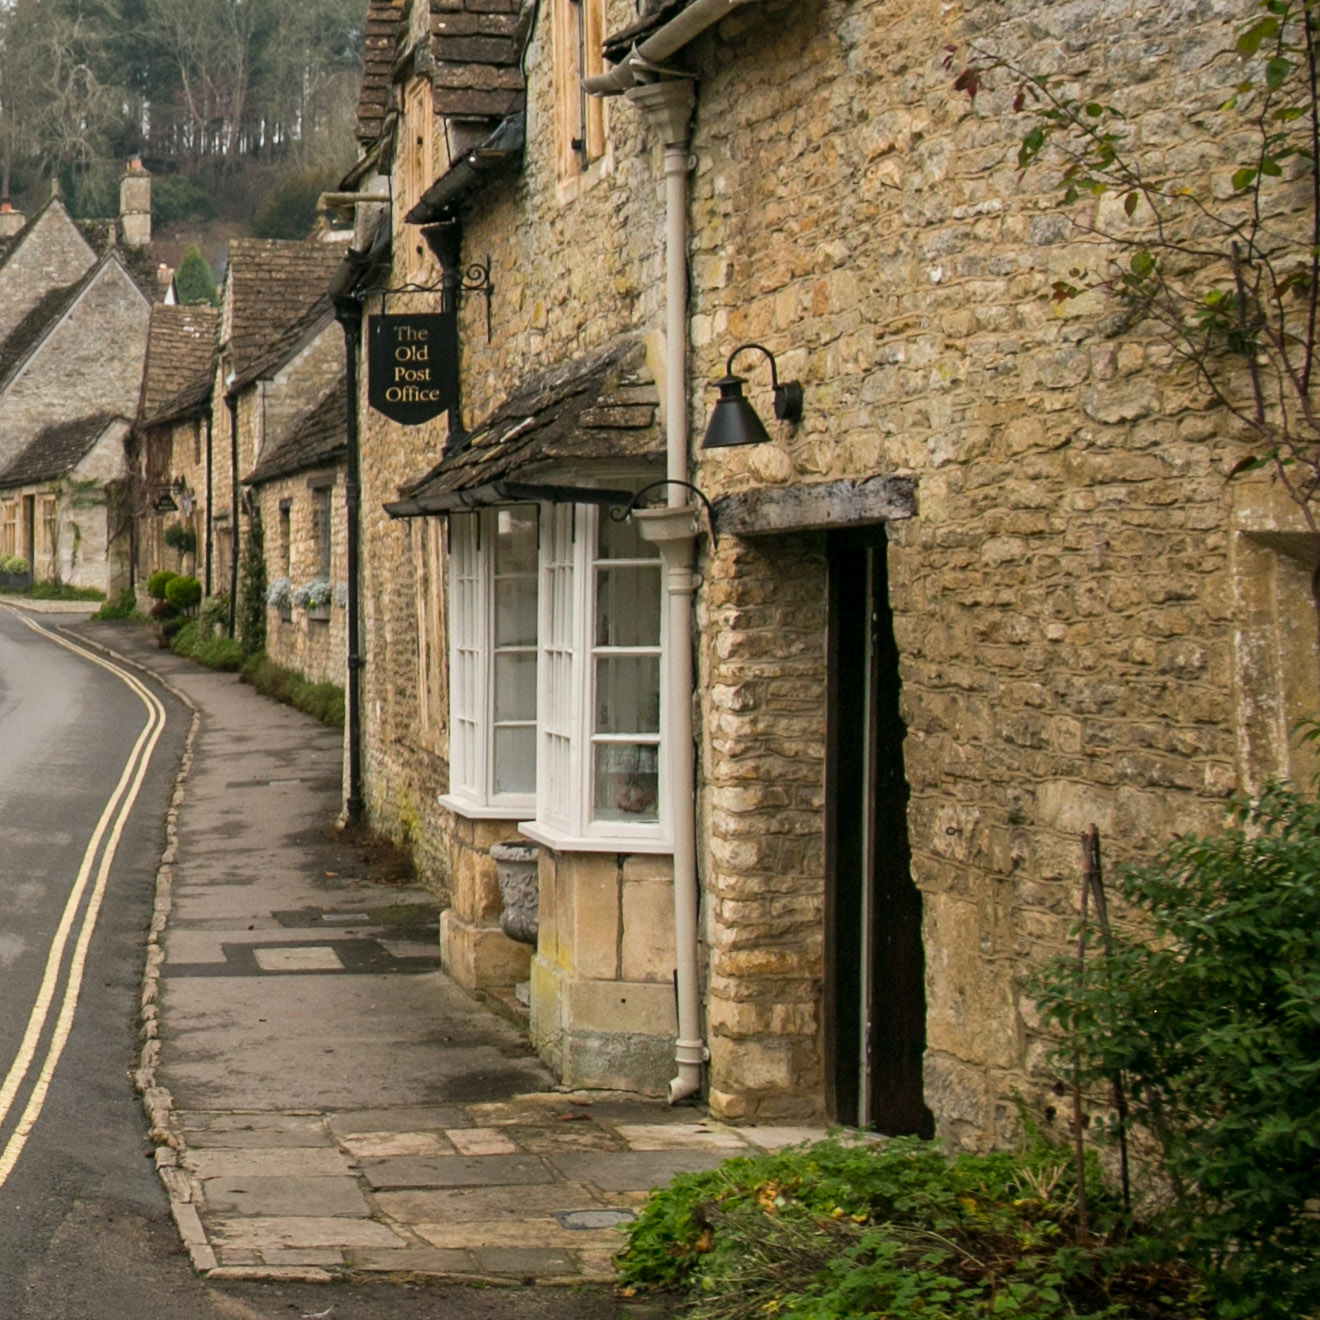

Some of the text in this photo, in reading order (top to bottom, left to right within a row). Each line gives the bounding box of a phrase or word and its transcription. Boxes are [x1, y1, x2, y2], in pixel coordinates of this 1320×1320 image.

[393, 325, 429, 341] The
[394, 345, 429, 361] Old
[394, 366, 431, 381] Post
[385, 386, 440, 402] Office
